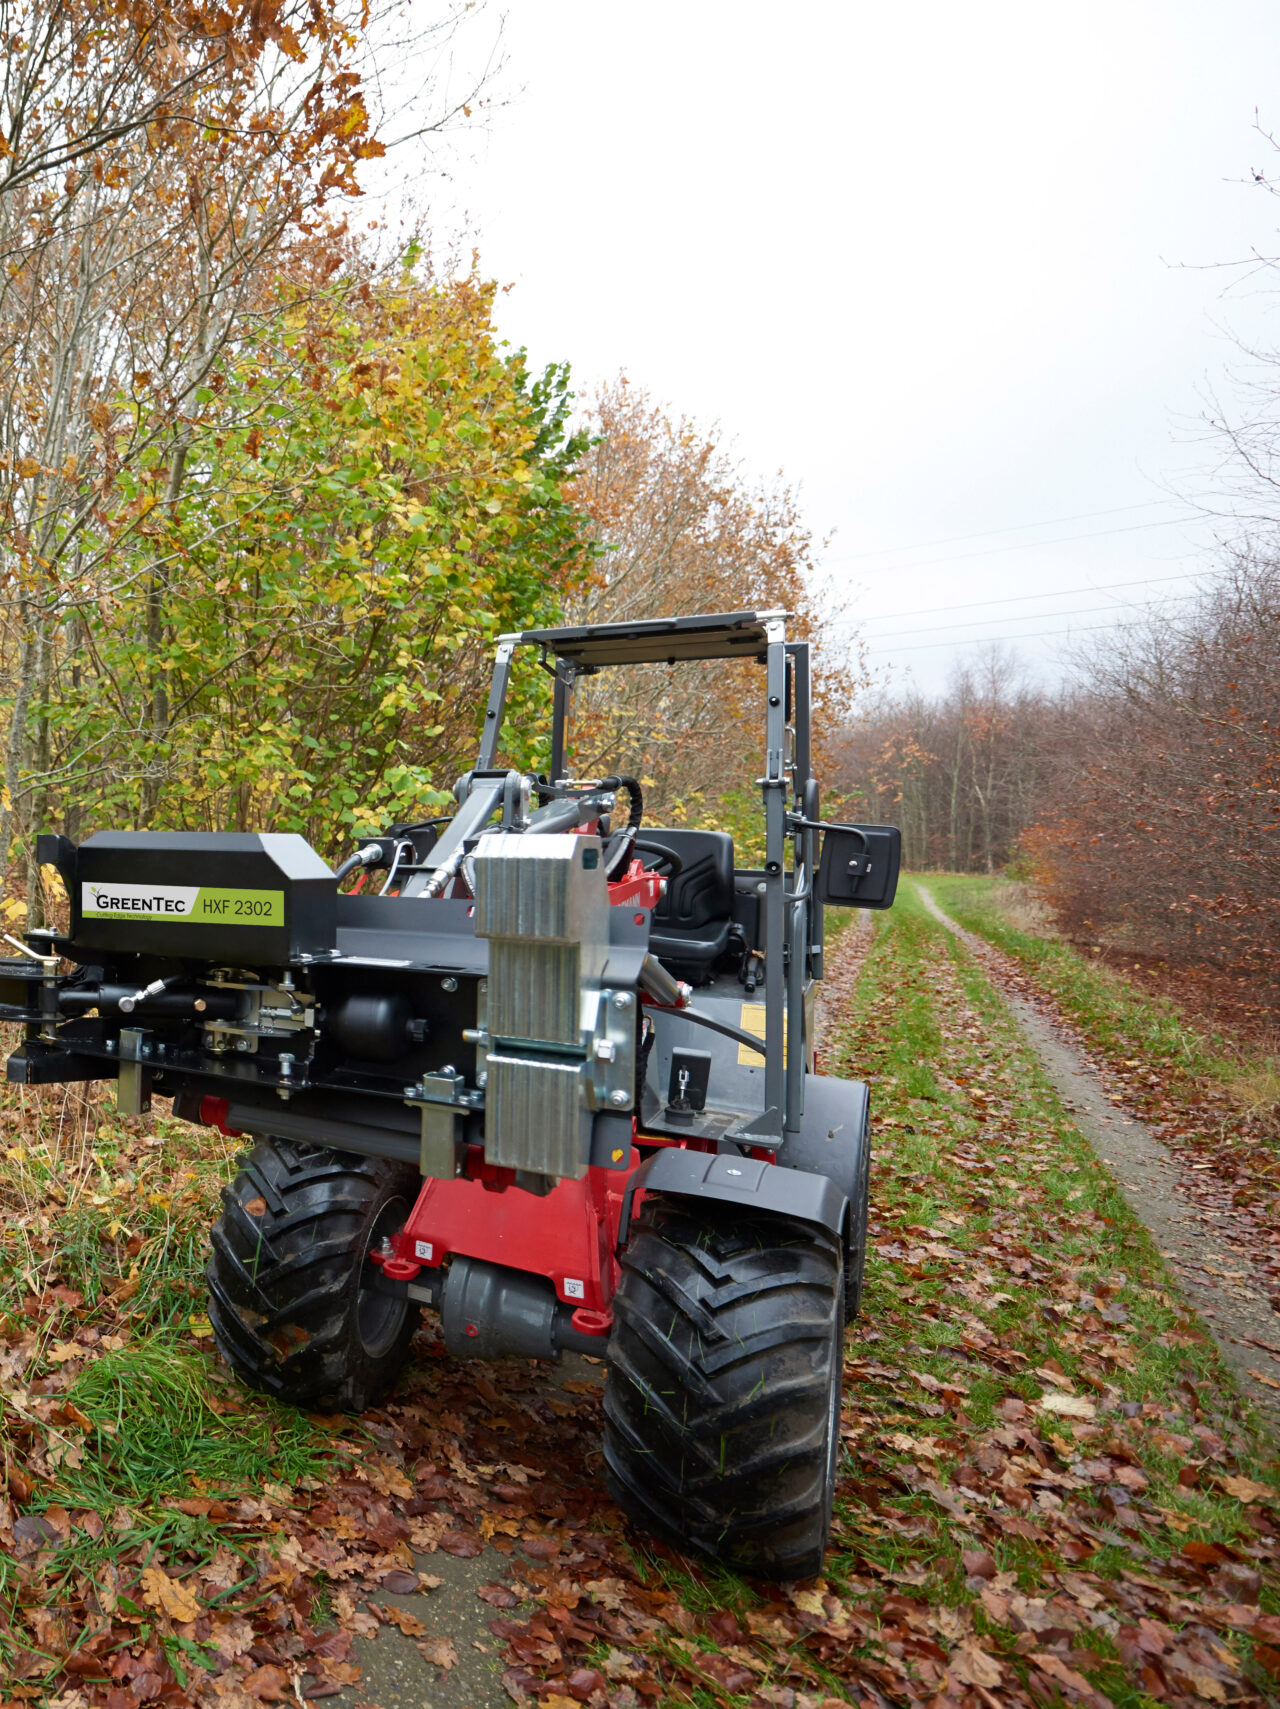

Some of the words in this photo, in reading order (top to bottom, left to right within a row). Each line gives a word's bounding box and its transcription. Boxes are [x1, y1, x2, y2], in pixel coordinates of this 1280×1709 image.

[96, 894, 185, 912] GREENTEC
[203, 899, 230, 914] HXF
[234, 900, 272, 916] 2302
